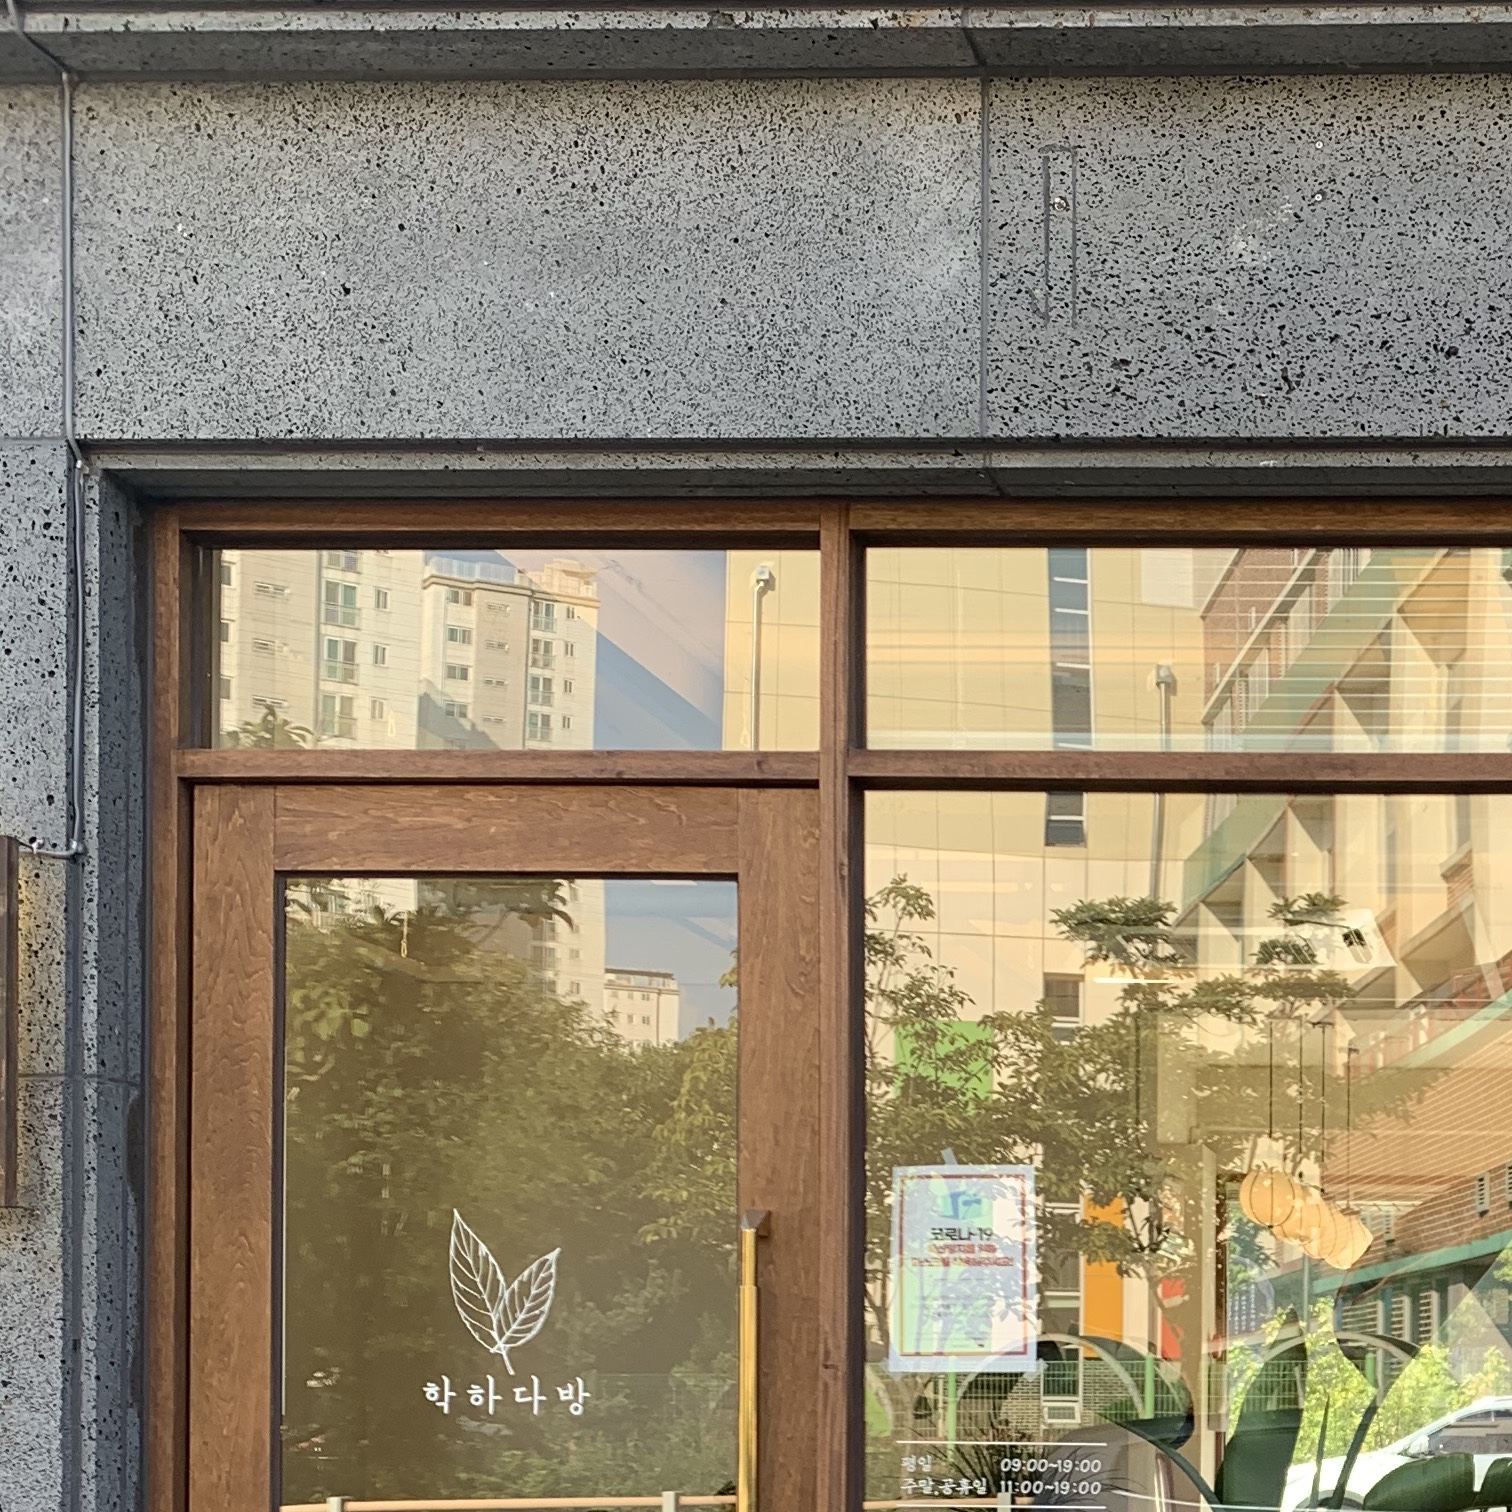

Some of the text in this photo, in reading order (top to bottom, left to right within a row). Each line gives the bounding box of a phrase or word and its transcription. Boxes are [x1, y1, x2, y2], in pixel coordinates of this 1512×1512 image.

[422, 1374, 592, 1416] 학하다방
[901, 1455, 1102, 1473] 평일 09:00~19:00
[999, 1480, 1102, 1495] 11:00~19:00
